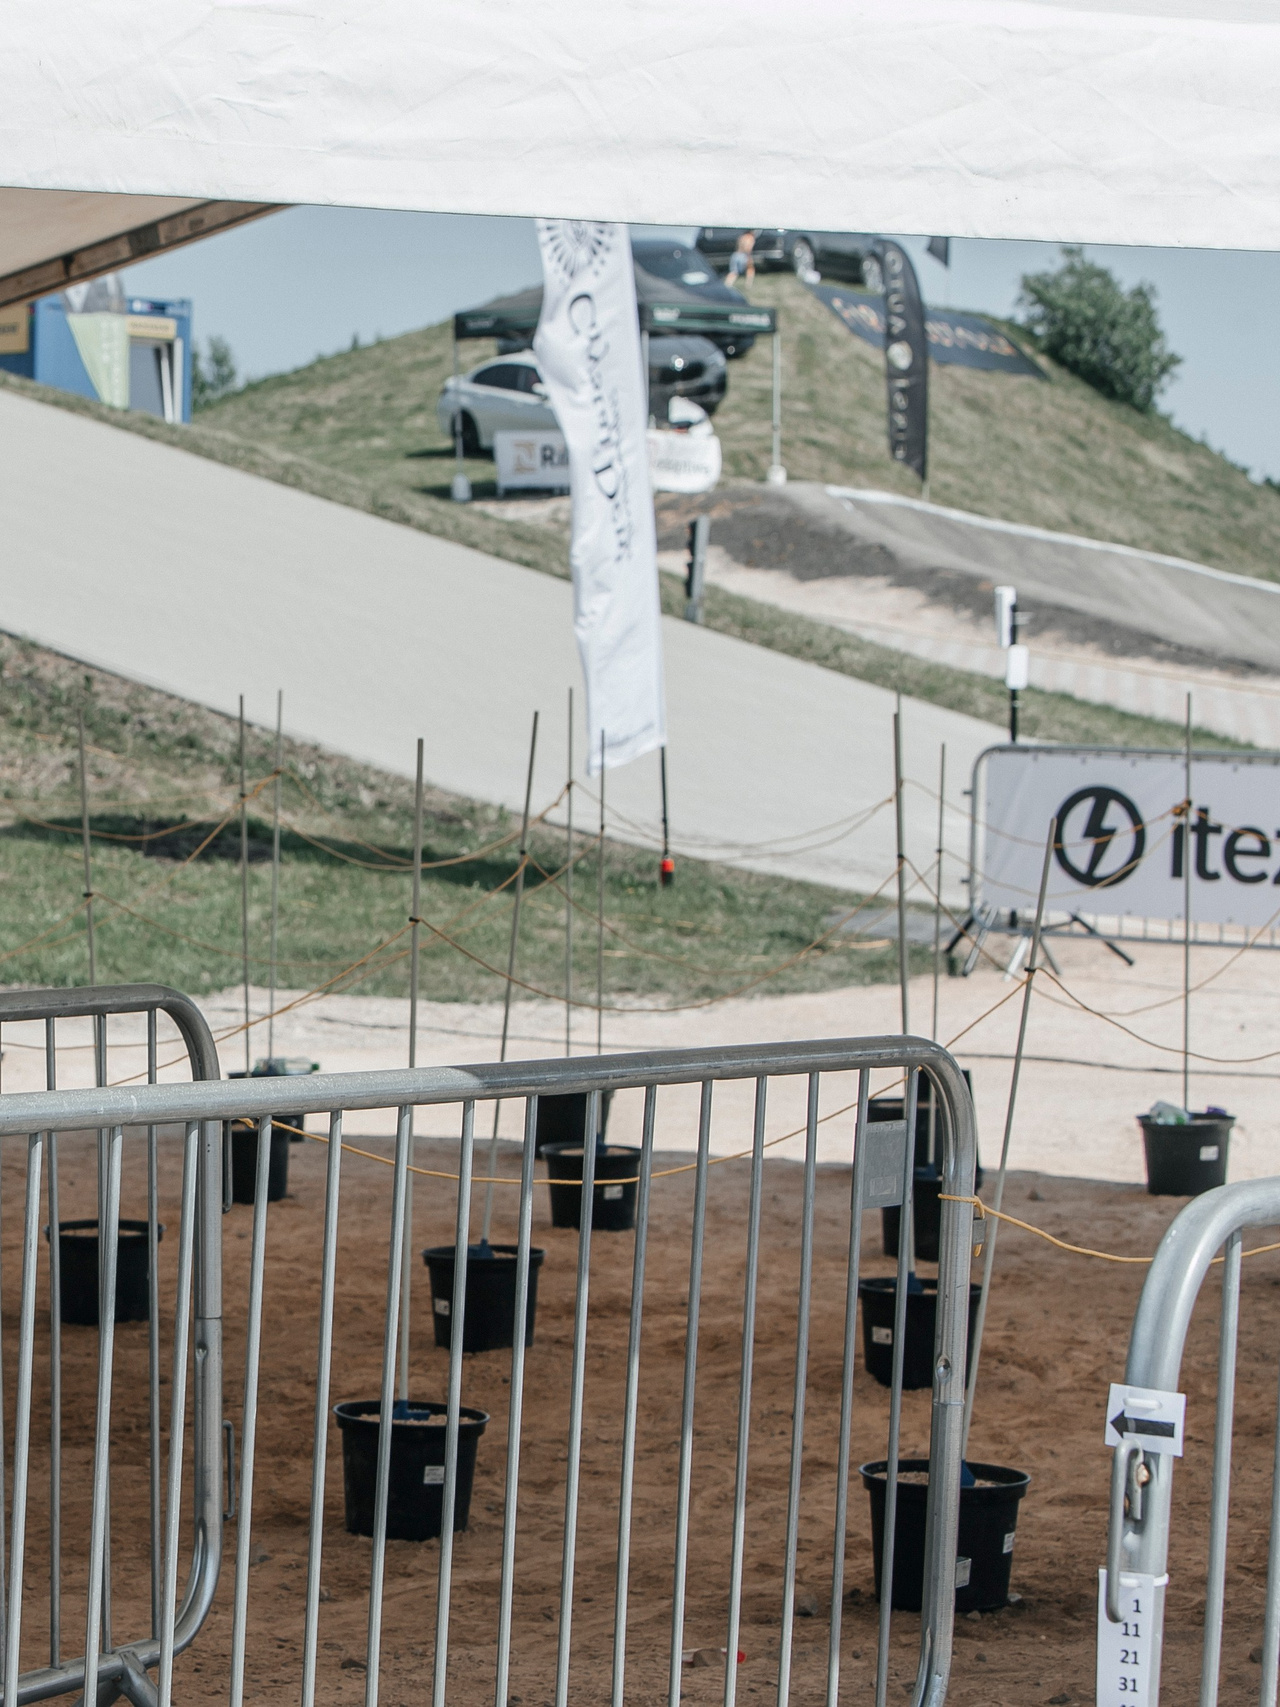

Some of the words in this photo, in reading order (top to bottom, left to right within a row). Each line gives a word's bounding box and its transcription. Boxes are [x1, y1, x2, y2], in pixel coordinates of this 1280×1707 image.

[1171, 806, 1280, 884] ite
[1132, 1599, 1141, 1613] 1
[1121, 1622, 1140, 1638] 11
[1120, 1649, 1139, 1665] 21
[1118, 1677, 1138, 1693] 31
